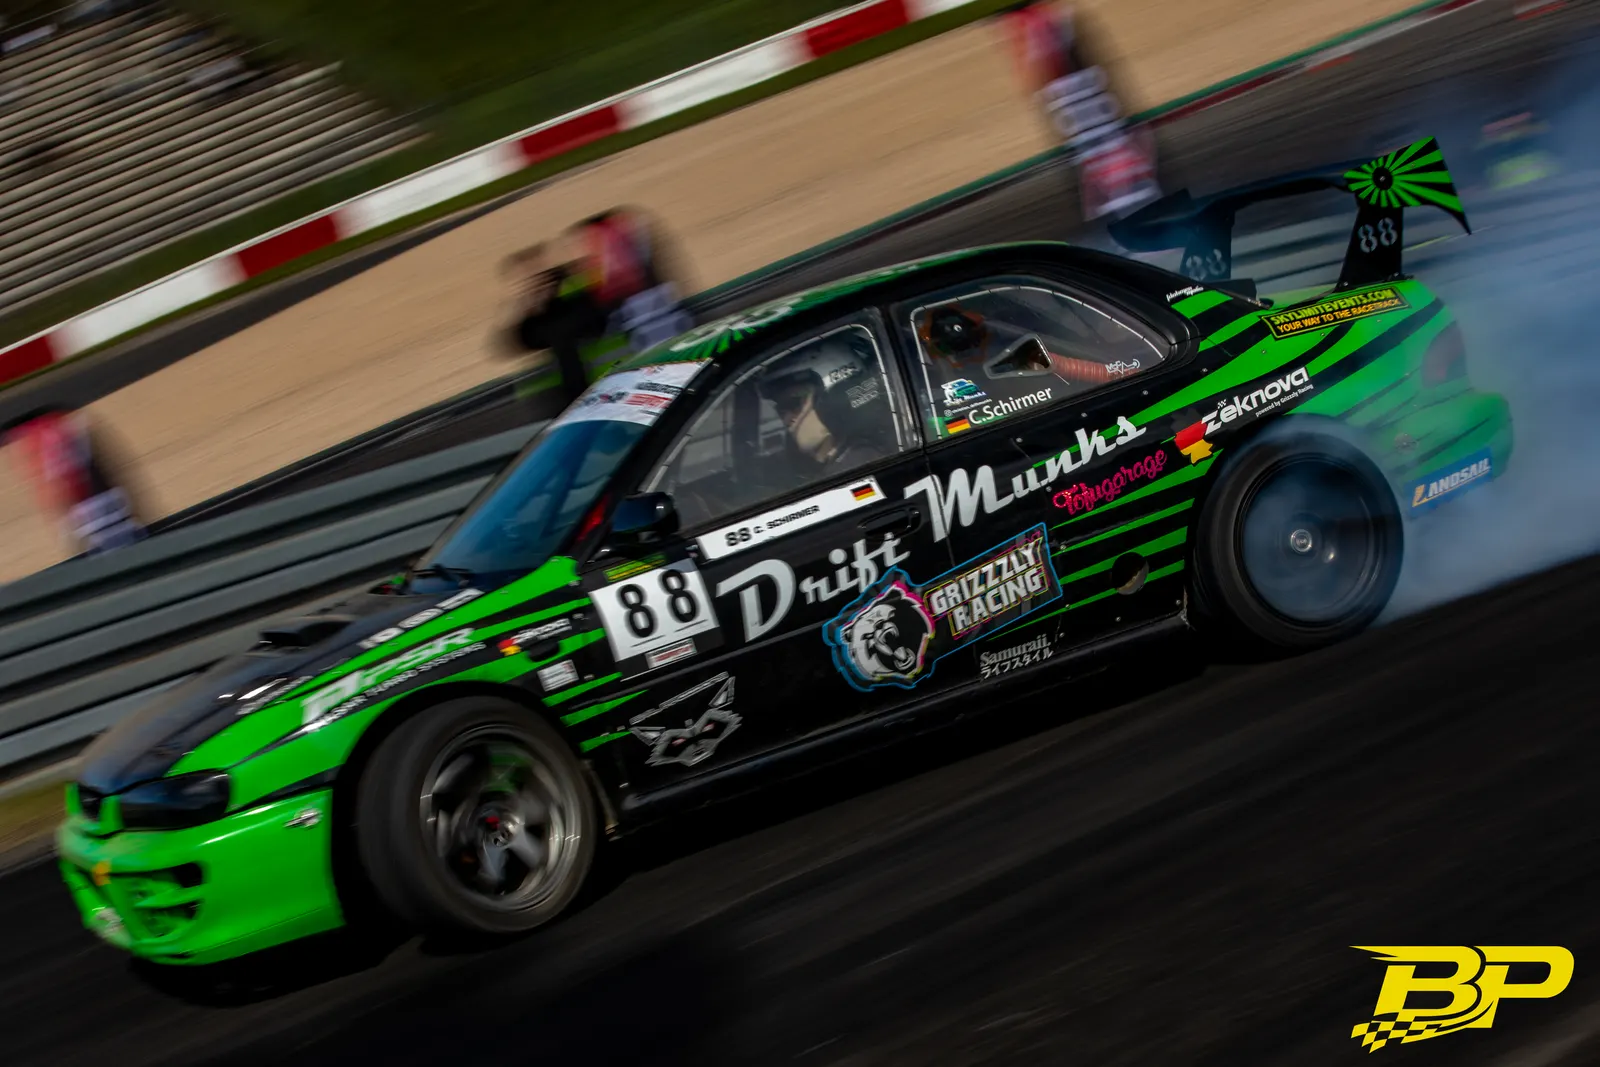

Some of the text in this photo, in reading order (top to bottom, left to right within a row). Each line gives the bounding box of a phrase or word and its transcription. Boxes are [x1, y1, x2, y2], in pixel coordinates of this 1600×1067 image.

[1358, 217, 1398, 253] 88
[1270, 287, 1396, 326] SKYLIMITEVENTS.COM
[1277, 298, 1401, 333] YOUR WAY TO THE RACETRACK
[968, 387, 1052, 425] C.Schirmer
[1255, 403, 1275, 418] powered
[1280, 391, 1299, 403] Grizzly
[1297, 384, 1314, 395] Racing
[1052, 450, 1168, 515] Tofugarage
[1412, 458, 1491, 507] LANDSAIL
[716, 416, 1147, 643] Drift Munks
[725, 527, 752, 547] 88
[767, 505, 820, 530] SCHIRMER
[929, 541, 1039, 615] GRIZZLY
[616, 569, 701, 639] 88
[952, 568, 1043, 631] RACING
[981, 647, 1054, 679] ライフスタイル
